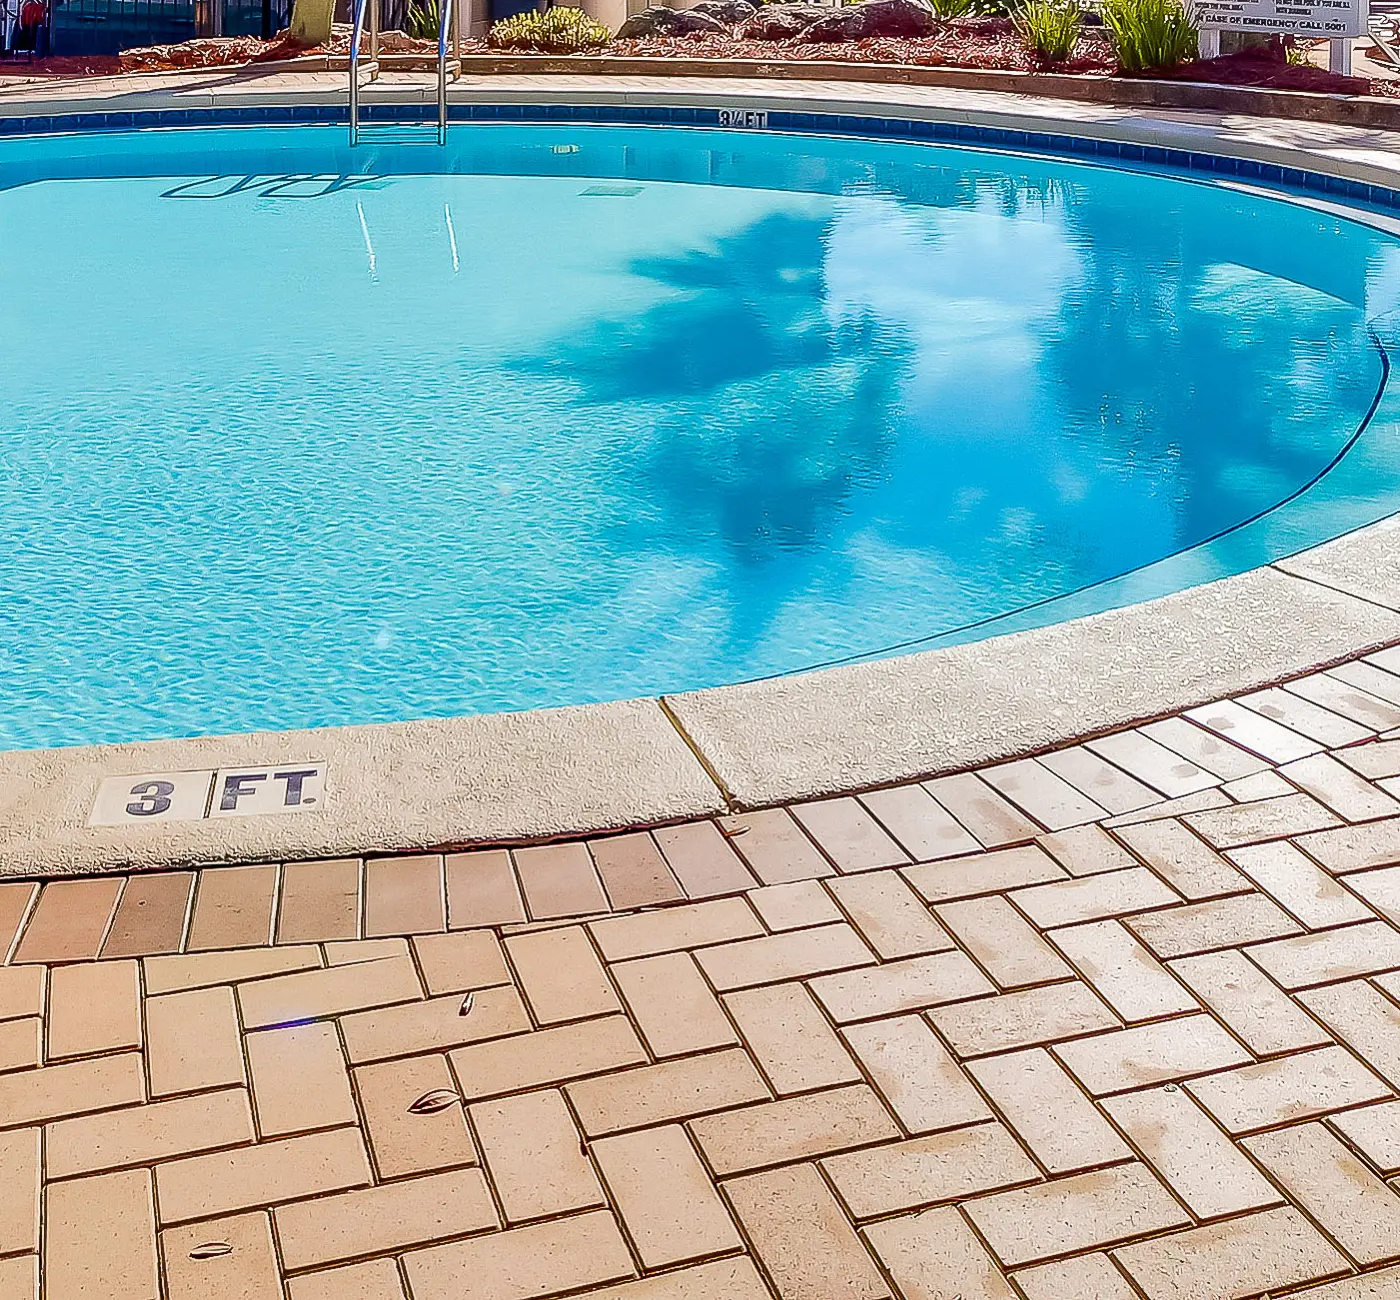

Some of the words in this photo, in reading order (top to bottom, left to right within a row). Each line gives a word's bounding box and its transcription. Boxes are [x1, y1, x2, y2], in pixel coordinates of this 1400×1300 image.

[1206, 14, 1228, 24] CASE
[1230, 16, 1241, 25] OF
[1243, 17, 1297, 28] EMERGENCY
[1300, 20, 1322, 30] CALL
[1325, 22, 1346, 32] 5001
[745, 111, 766, 127] FT
[125, 780, 175, 816] 3
[220, 769, 318, 811] FT.
